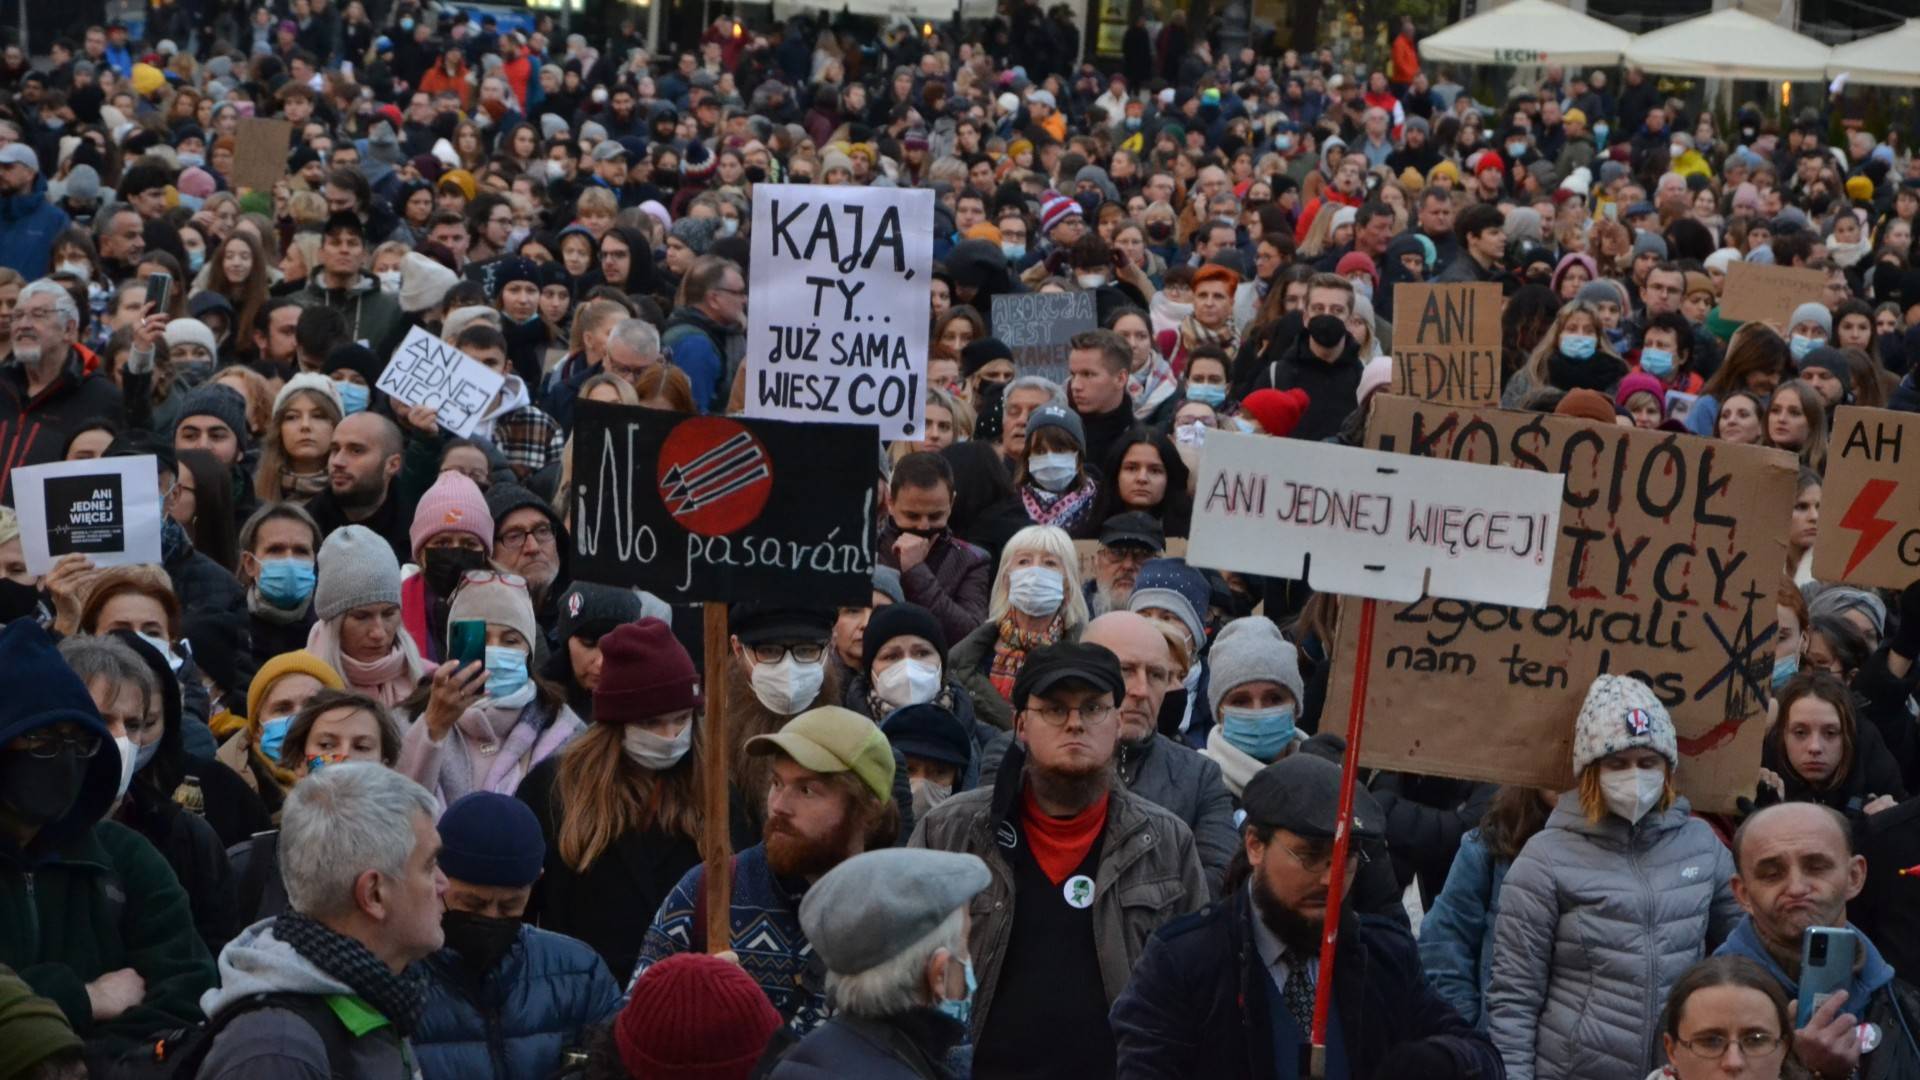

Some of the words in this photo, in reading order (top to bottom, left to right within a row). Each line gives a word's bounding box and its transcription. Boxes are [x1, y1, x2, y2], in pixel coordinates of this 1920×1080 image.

[1494, 48, 1538, 62] LECH
[771, 199, 915, 280] KAJA,
[806, 276, 891, 321] TY...
[1416, 287, 1475, 345] ANI
[408, 337, 463, 373] ANI
[768, 322, 821, 363] JUŻ
[830, 332, 911, 370] SAMA
[394, 348, 491, 415] JEDNEJ
[1395, 350, 1495, 400] JEDNEJ
[758, 369, 841, 413] WIESZ
[847, 373, 918, 436] CO!
[1841, 420, 1903, 464] AH
[1410, 411, 1736, 527] KOŚCIÓŁ
[69, 500, 113, 513] JEDNEJ
[92, 487, 112, 500] ANI
[69, 511, 113, 525] WIĘCEJ
[1205, 470, 1267, 515] ANI
[1277, 481, 1391, 536] JEDNEJ
[1407, 499, 1549, 565] WIĘCEJ!
[1386, 645, 1476, 676] nam
[1499, 643, 1568, 689] ten
